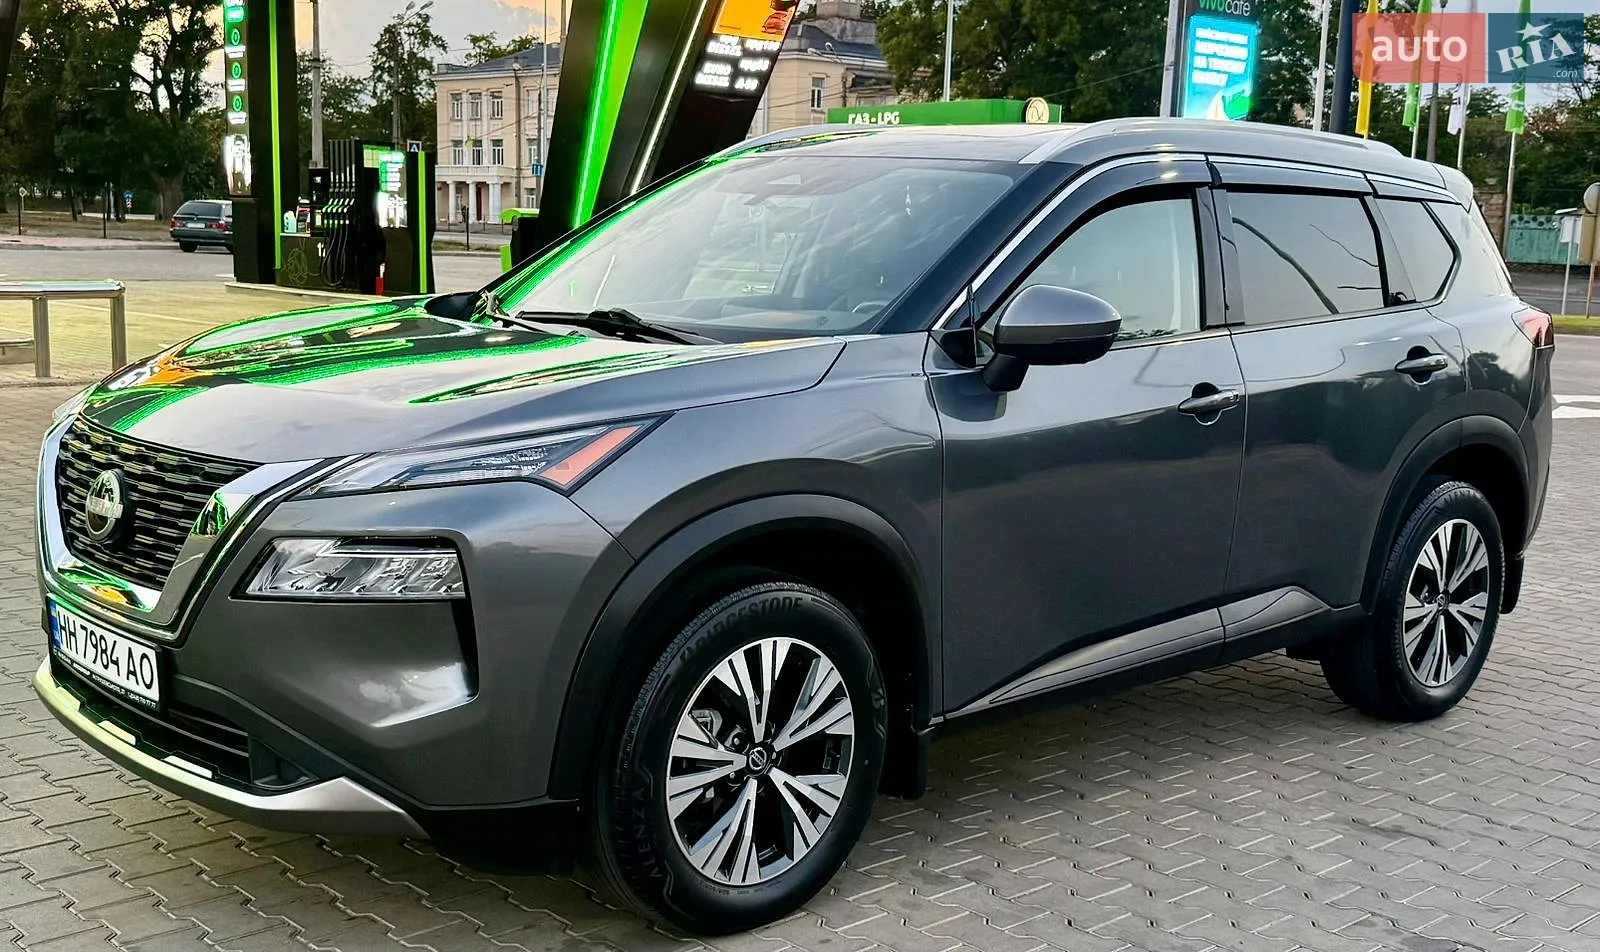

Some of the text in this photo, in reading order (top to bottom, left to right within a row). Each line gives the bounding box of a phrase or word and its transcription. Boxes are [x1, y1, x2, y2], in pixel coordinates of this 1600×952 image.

[58, 610, 79, 655] HH
[79, 624, 121, 677] 7984
[126, 646, 155, 690] AO
[631, 787, 663, 878] ALENZA
